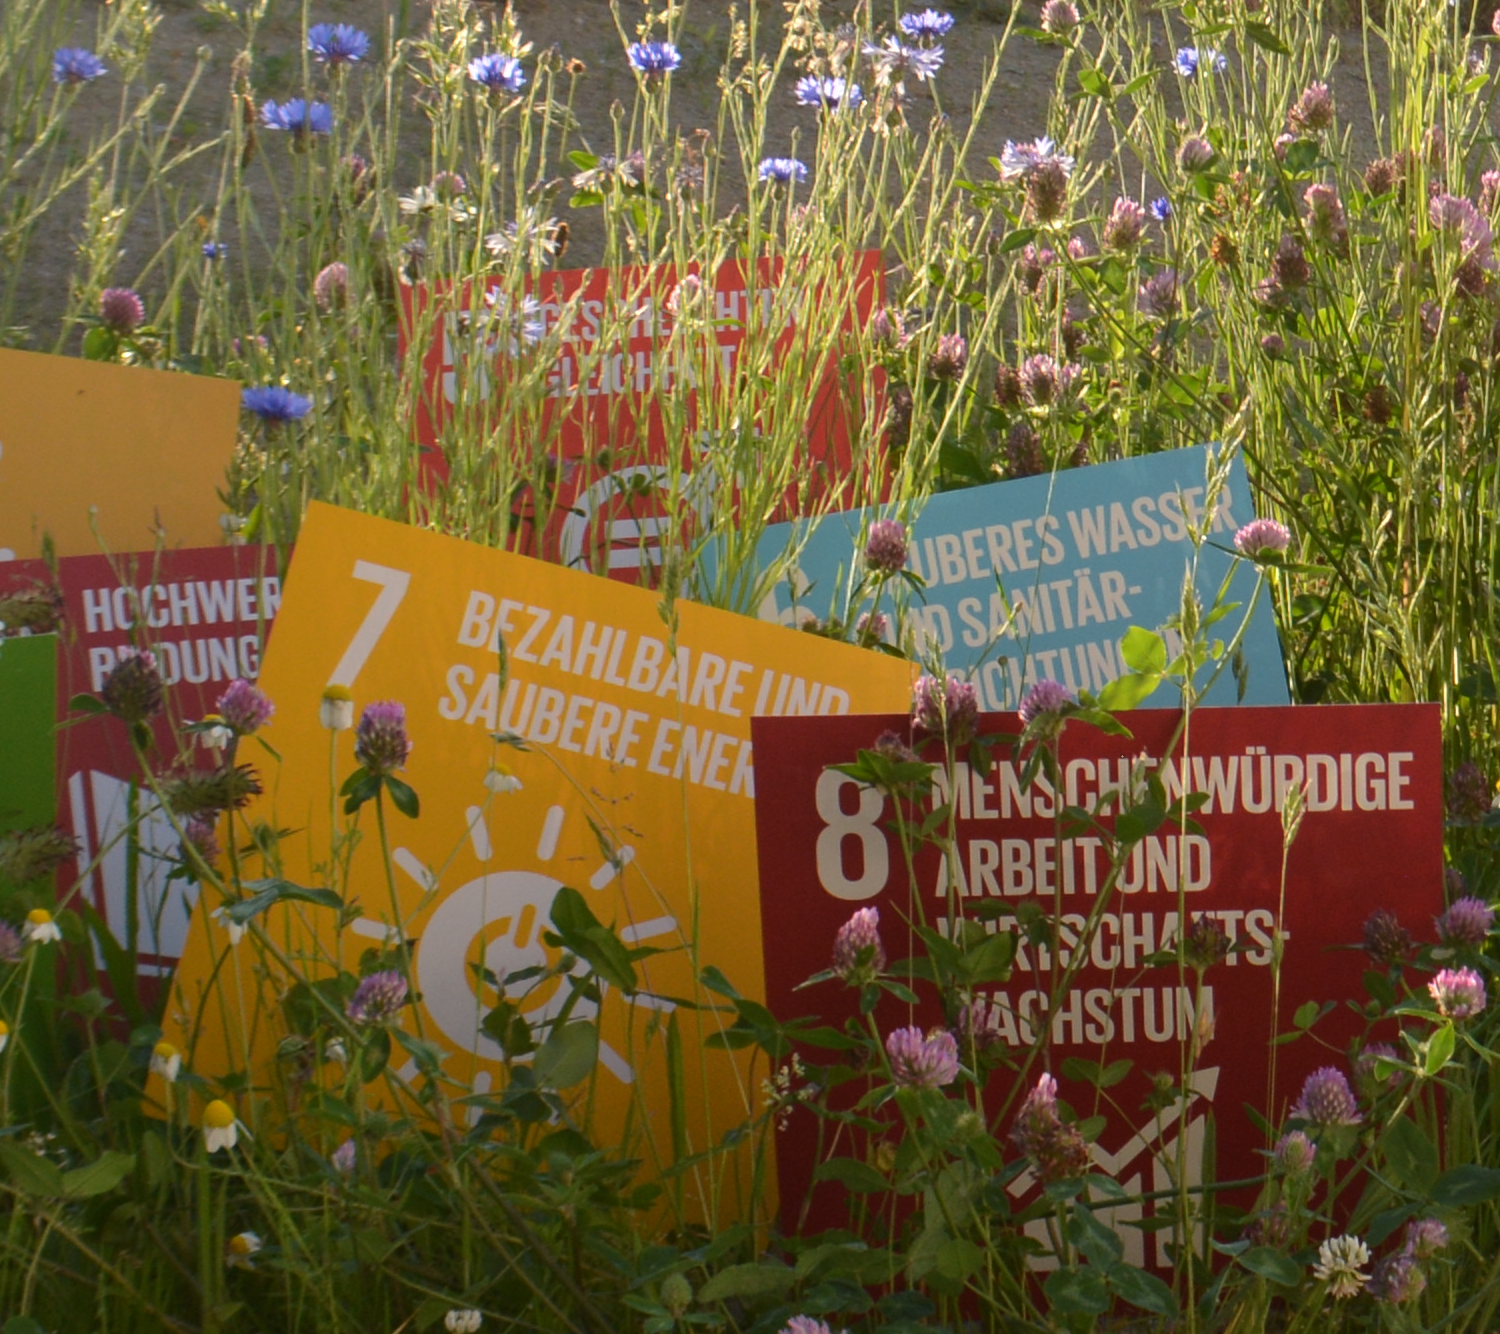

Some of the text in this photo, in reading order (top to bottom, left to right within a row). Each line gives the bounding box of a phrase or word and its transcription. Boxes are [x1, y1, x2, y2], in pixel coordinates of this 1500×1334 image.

[1066, 482, 1240, 560] WASSER
[327, 559, 411, 689] 7
[456, 590, 753, 718] BEZAHLBARE
[956, 568, 1144, 649] SANITÄR-
[437, 664, 639, 767] SAUBERE
[815, 767, 890, 901] 8
[934, 834, 1212, 898] ARBEIT UND
[964, 985, 1216, 1048] ACHSTUM
